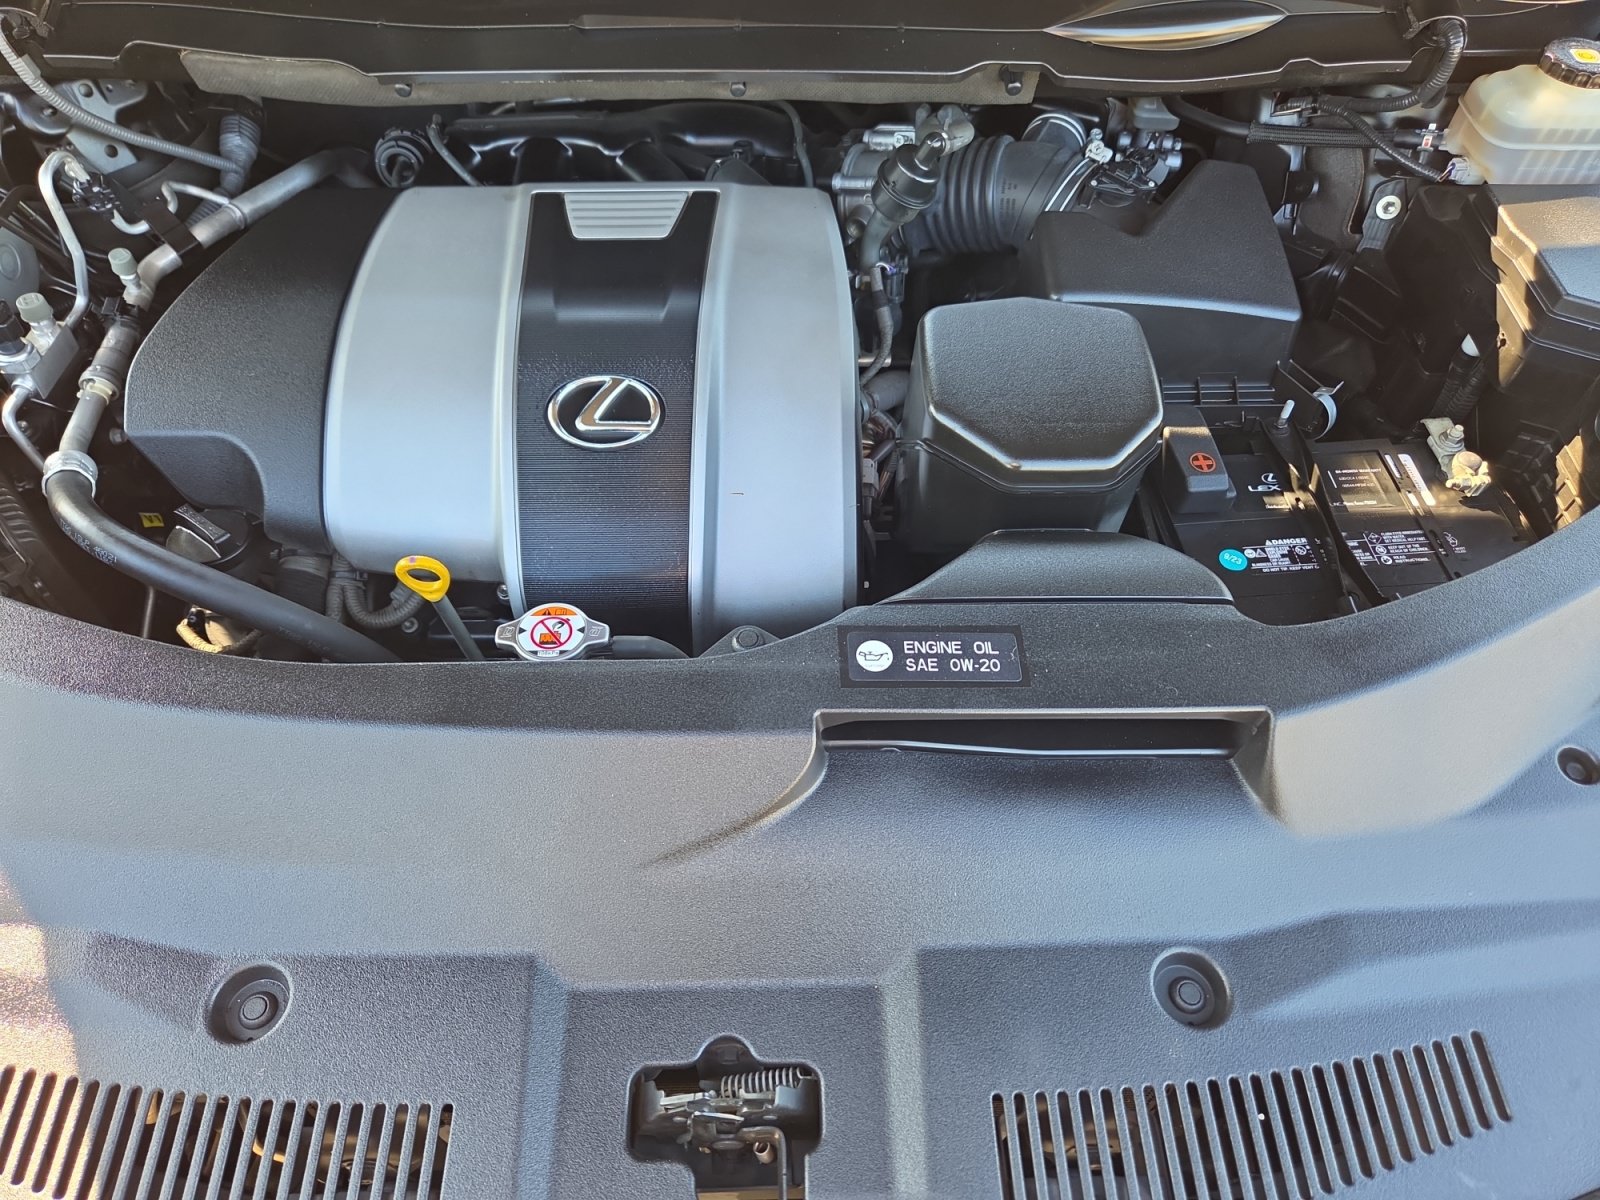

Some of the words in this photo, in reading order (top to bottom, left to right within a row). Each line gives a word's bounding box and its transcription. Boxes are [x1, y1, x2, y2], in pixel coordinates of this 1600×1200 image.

[904, 641, 962, 654] ENGINE
[973, 641, 1000, 655] OIL
[906, 658, 938, 671] SAE
[950, 658, 1000, 672] 0W-20
